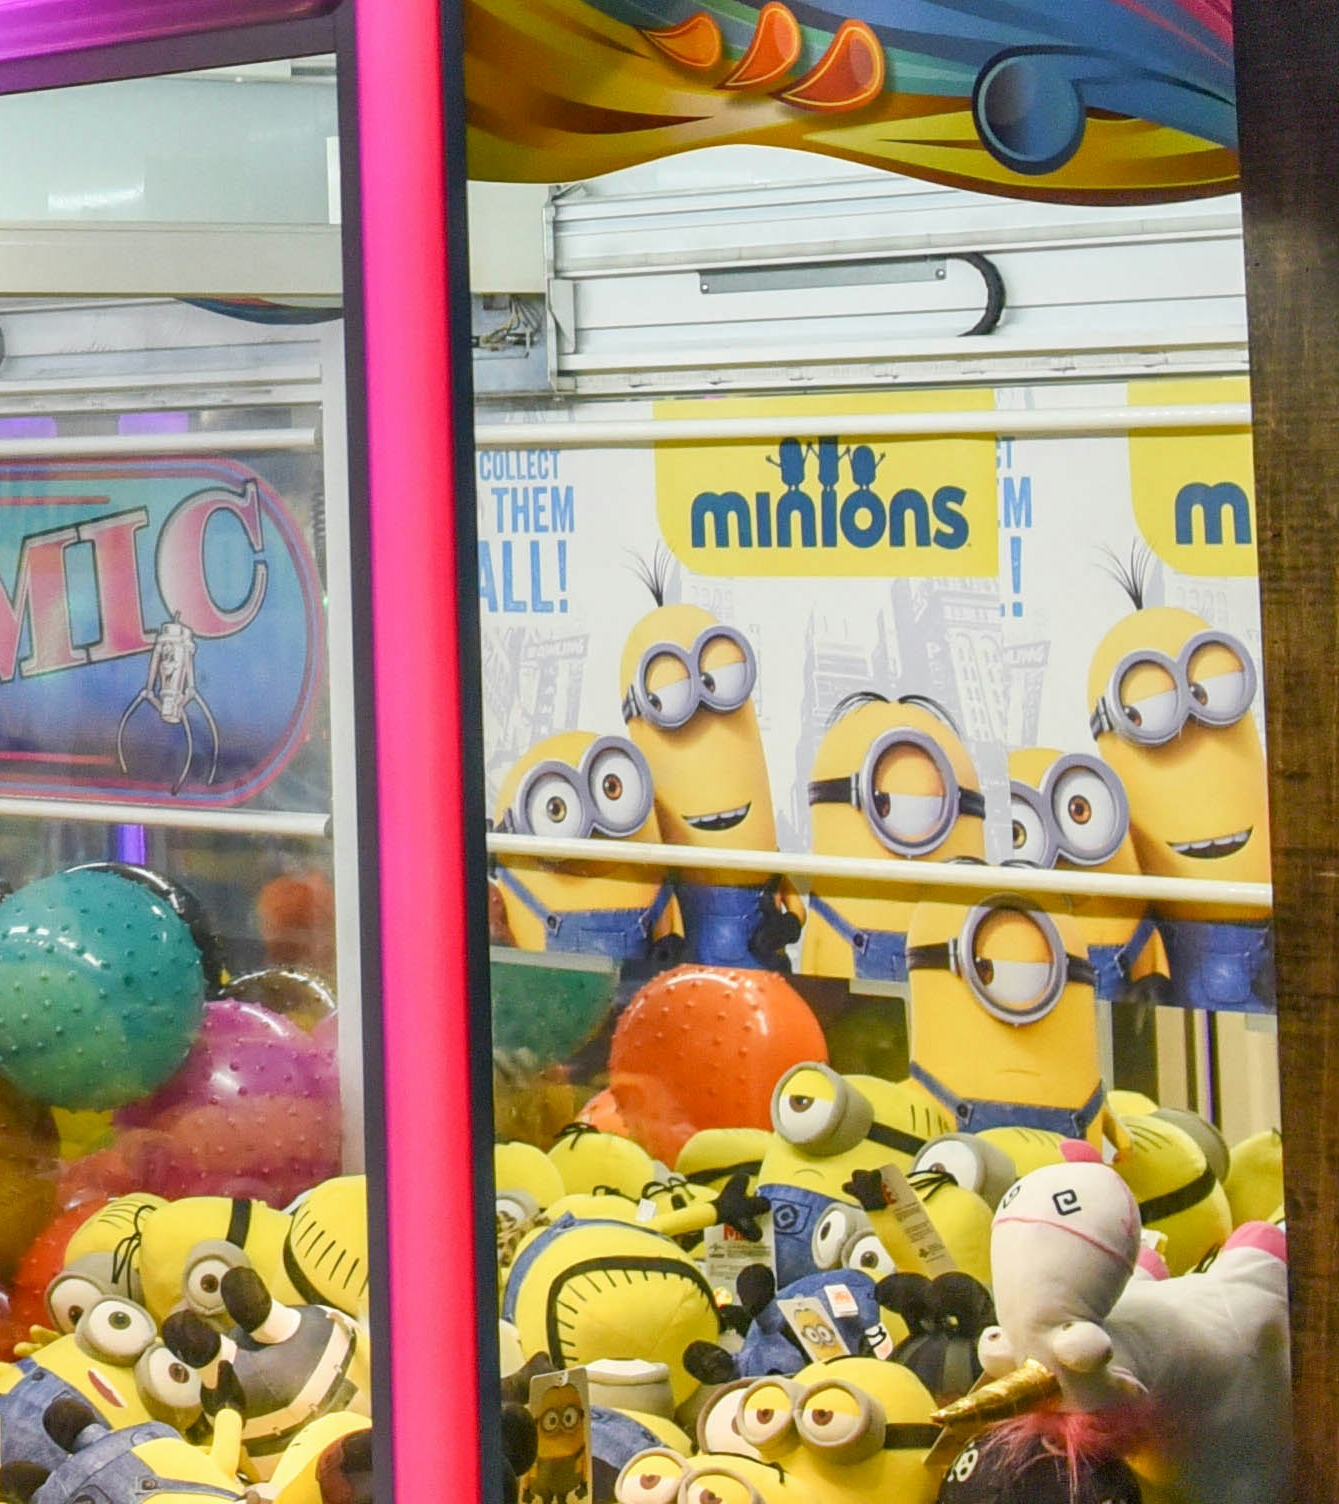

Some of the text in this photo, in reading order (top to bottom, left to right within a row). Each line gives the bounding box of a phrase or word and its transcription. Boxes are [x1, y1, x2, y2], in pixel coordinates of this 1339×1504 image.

[479, 449, 561, 481] COLLECT
[491, 485, 575, 534] THEM
[690, 485, 970, 550] minions
[478, 539, 569, 613] ALL!
